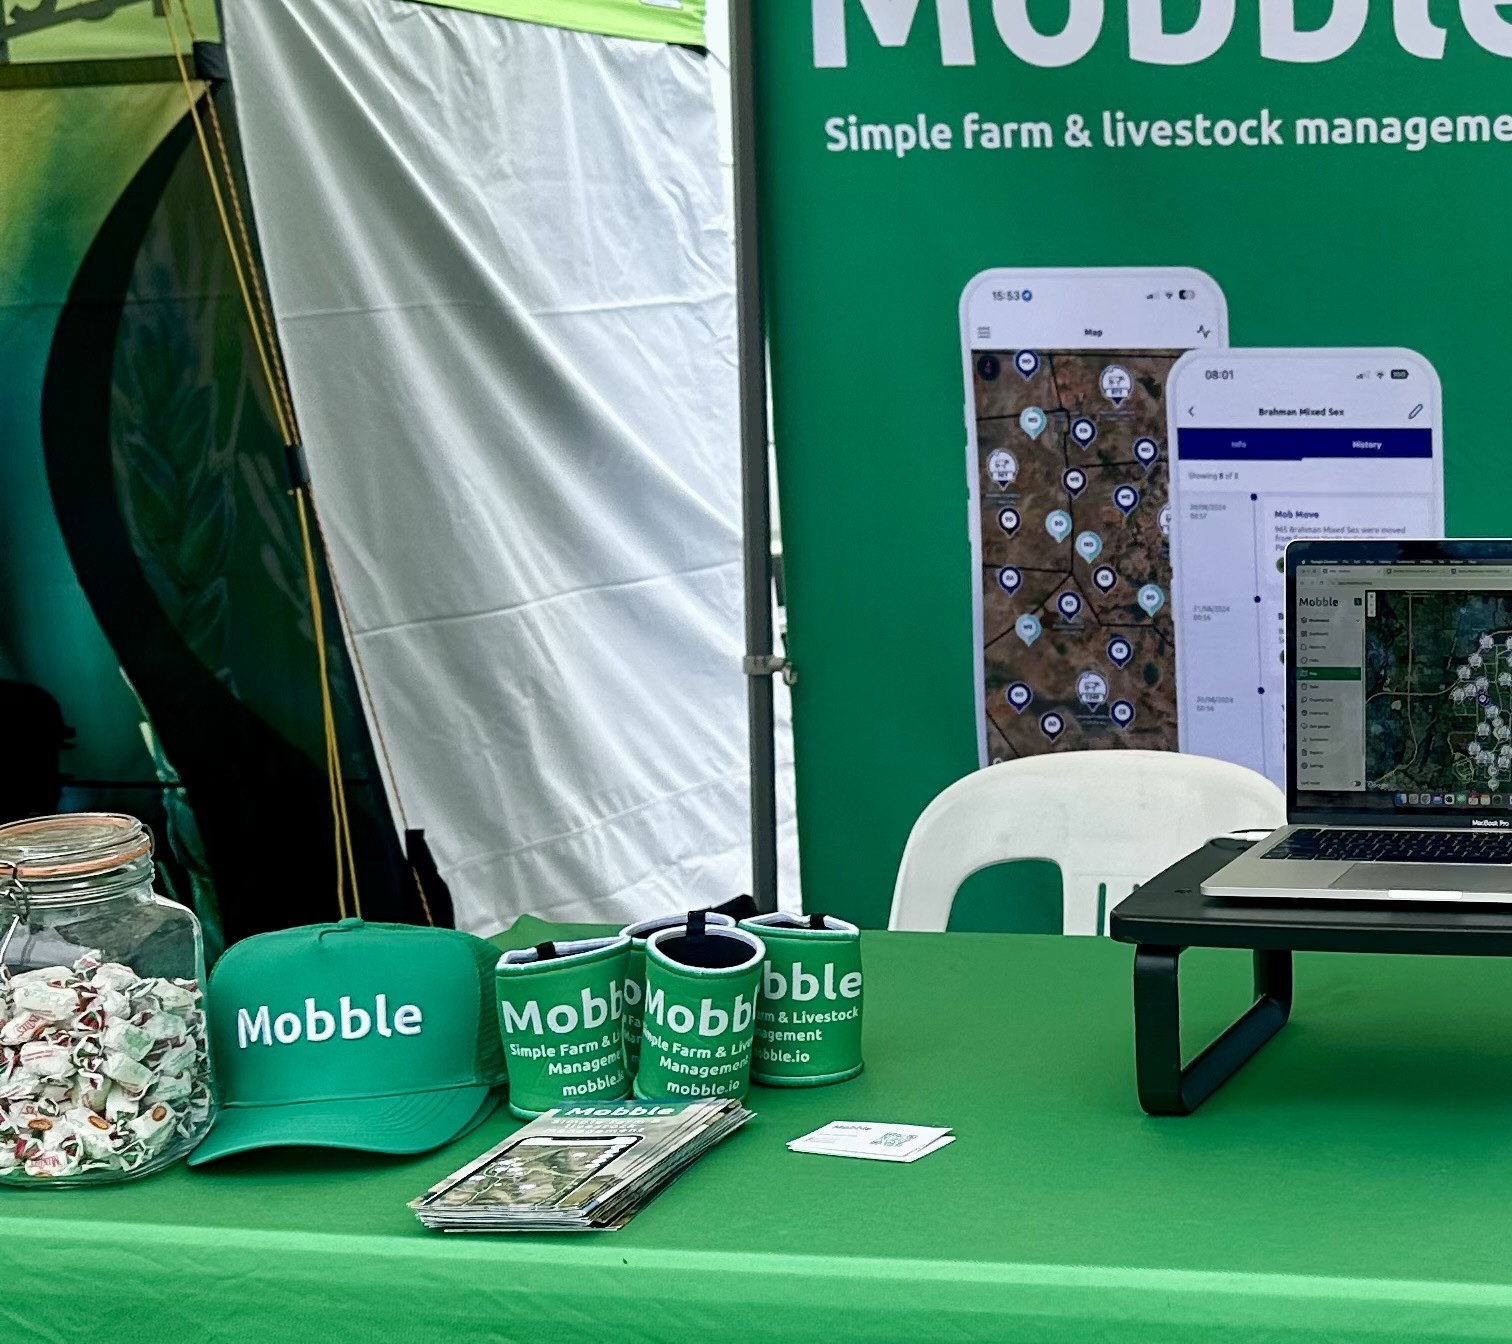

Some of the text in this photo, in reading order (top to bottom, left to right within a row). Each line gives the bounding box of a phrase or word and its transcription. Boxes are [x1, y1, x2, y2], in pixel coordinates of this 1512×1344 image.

[824, 113, 953, 159] Simple
[963, 111, 1053, 150] farm
[1064, 113, 1093, 148] &
[1102, 108, 1284, 147] livestock
[1205, 369, 1234, 381] 08:01
[1258, 408, 1297, 417] Brahman
[1299, 408, 1326, 417] Mixed
[1299, 597, 1339, 607] Mobble
[237, 993, 423, 1049] Mobble
[777, 1011, 789, 1024] &
[793, 1005, 859, 1024] Livestock
[509, 1043, 556, 1060] Simple
[560, 1040, 599, 1056] Farm
[601, 1035, 611, 1048] &
[672, 1042, 711, 1059] Farm
[715, 1046, 727, 1059] &
[666, 1079, 741, 1097] mobble.io
[565, 1106, 675, 1116] Mobble
